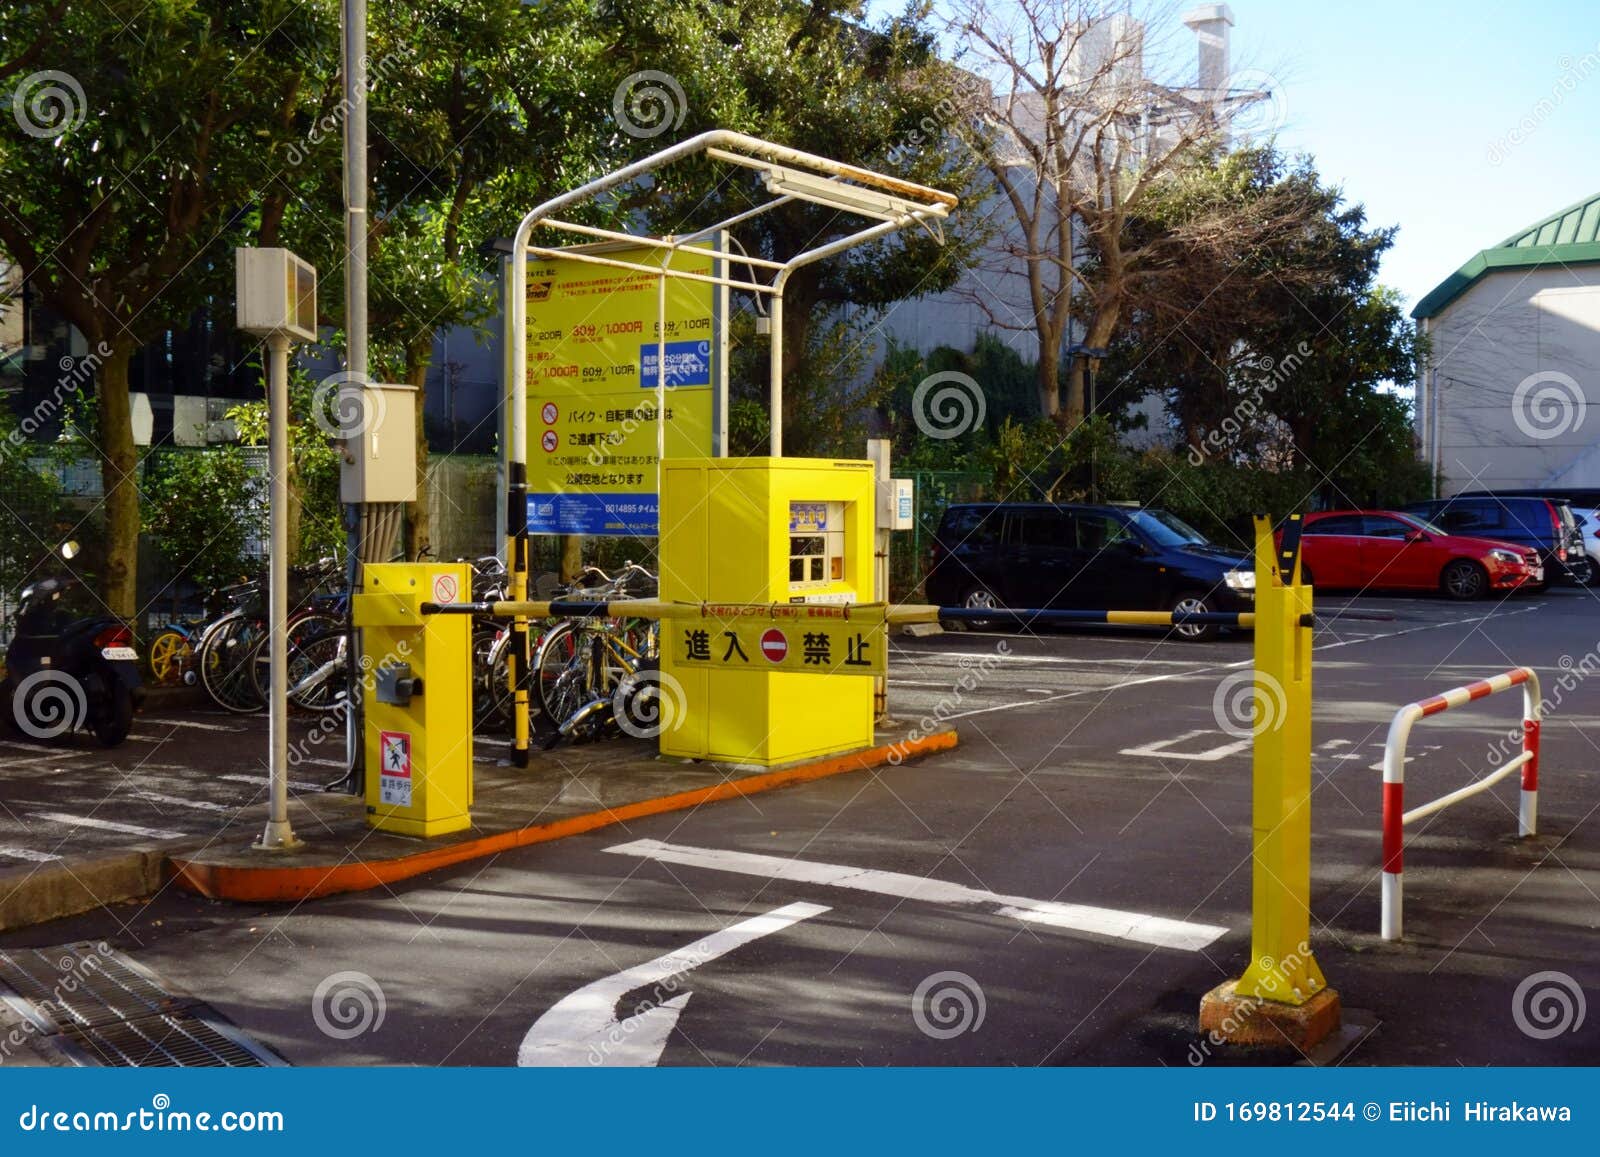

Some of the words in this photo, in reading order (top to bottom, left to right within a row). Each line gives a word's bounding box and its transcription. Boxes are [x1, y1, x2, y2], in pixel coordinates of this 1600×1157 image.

[654, 318, 710, 331] 6分/100円
[685, 629, 749, 663] 進入
[803, 631, 872, 666] 禁止
